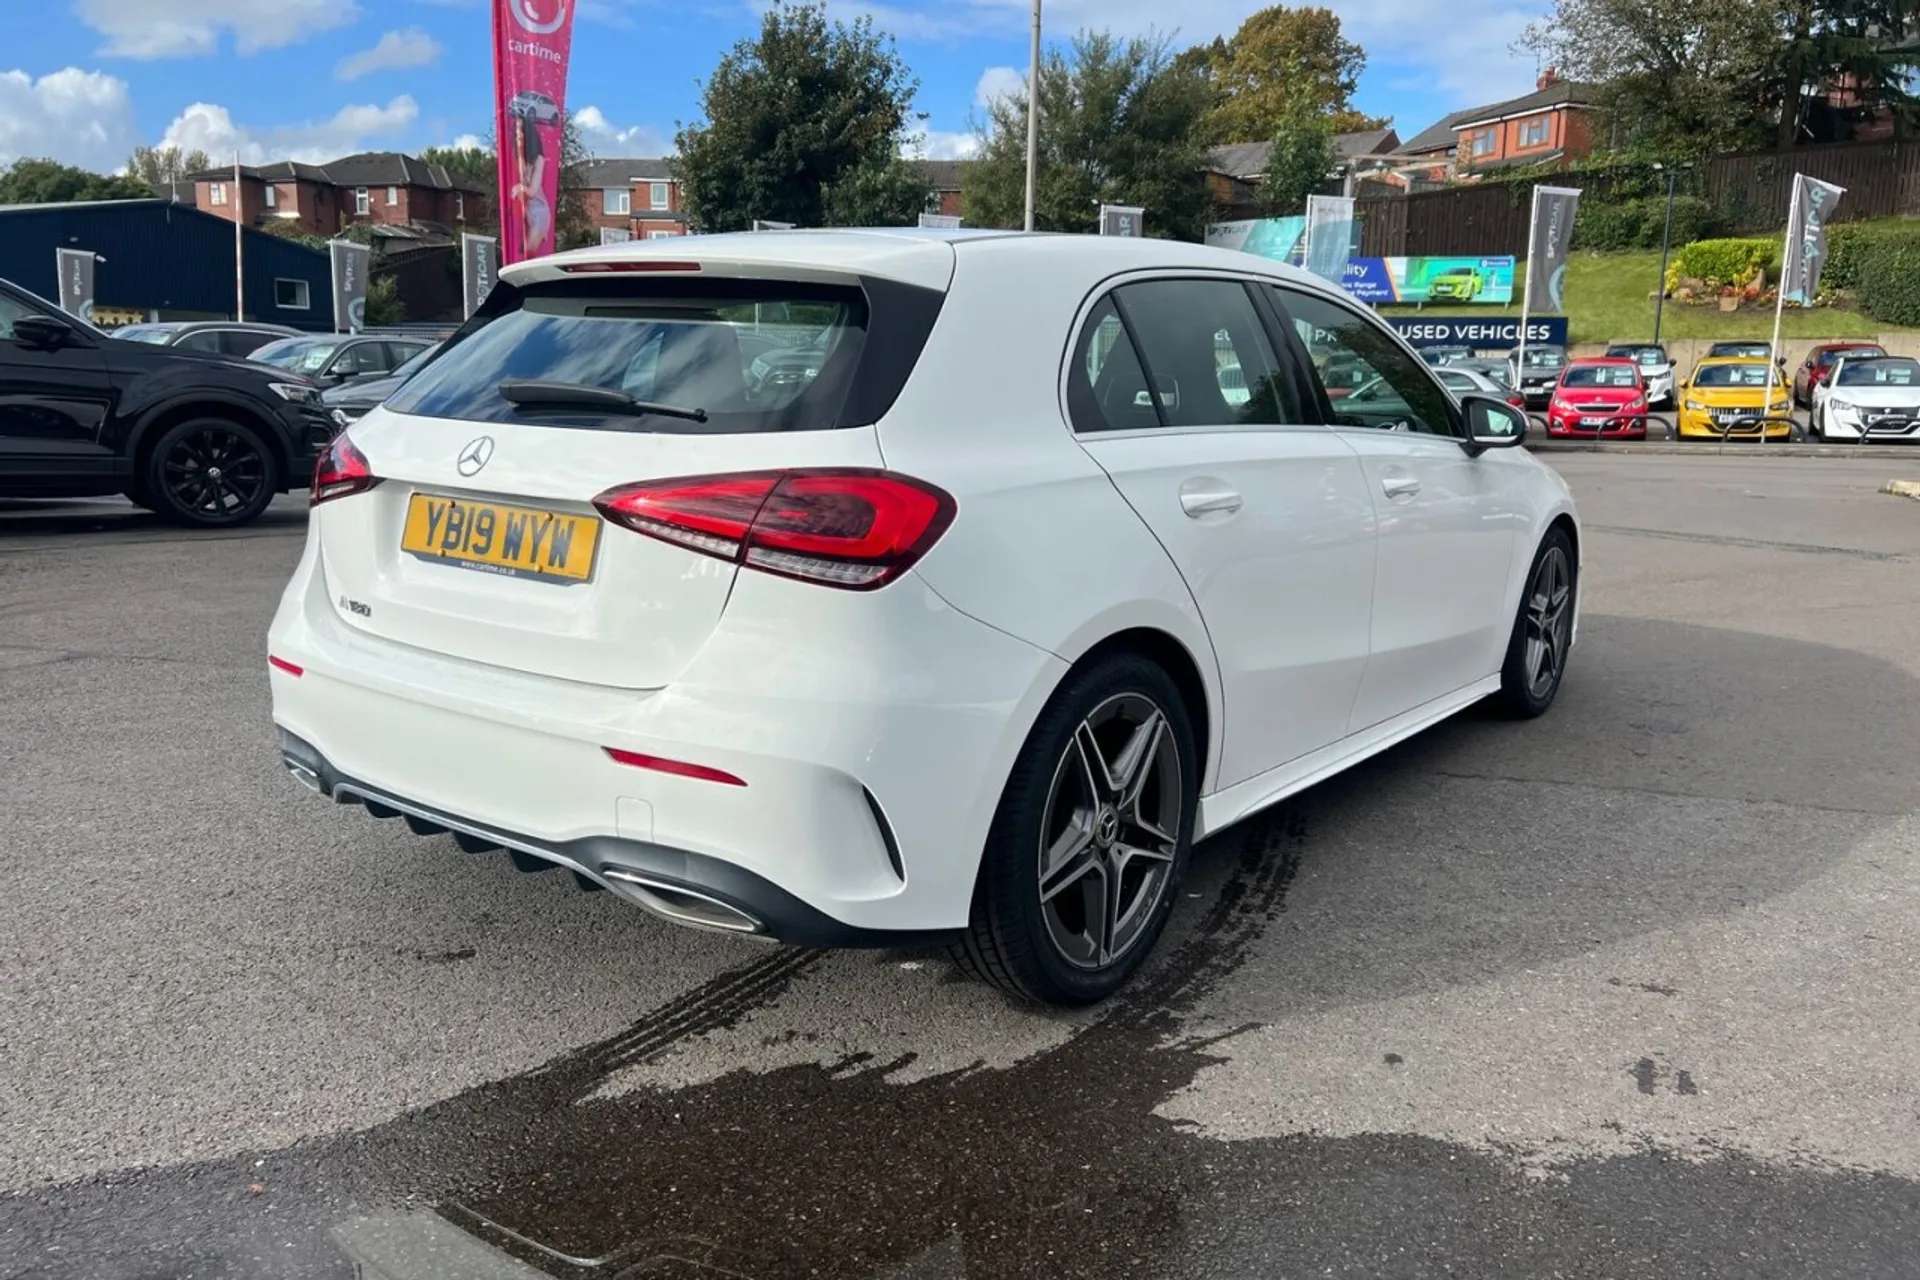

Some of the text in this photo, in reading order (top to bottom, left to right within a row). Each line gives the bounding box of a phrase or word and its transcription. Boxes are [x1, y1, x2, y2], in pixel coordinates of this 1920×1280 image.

[508, 39, 561, 64] cartime
[1399, 325, 1551, 341] USED VEHICLES
[427, 501, 575, 569] YB19 WYW
